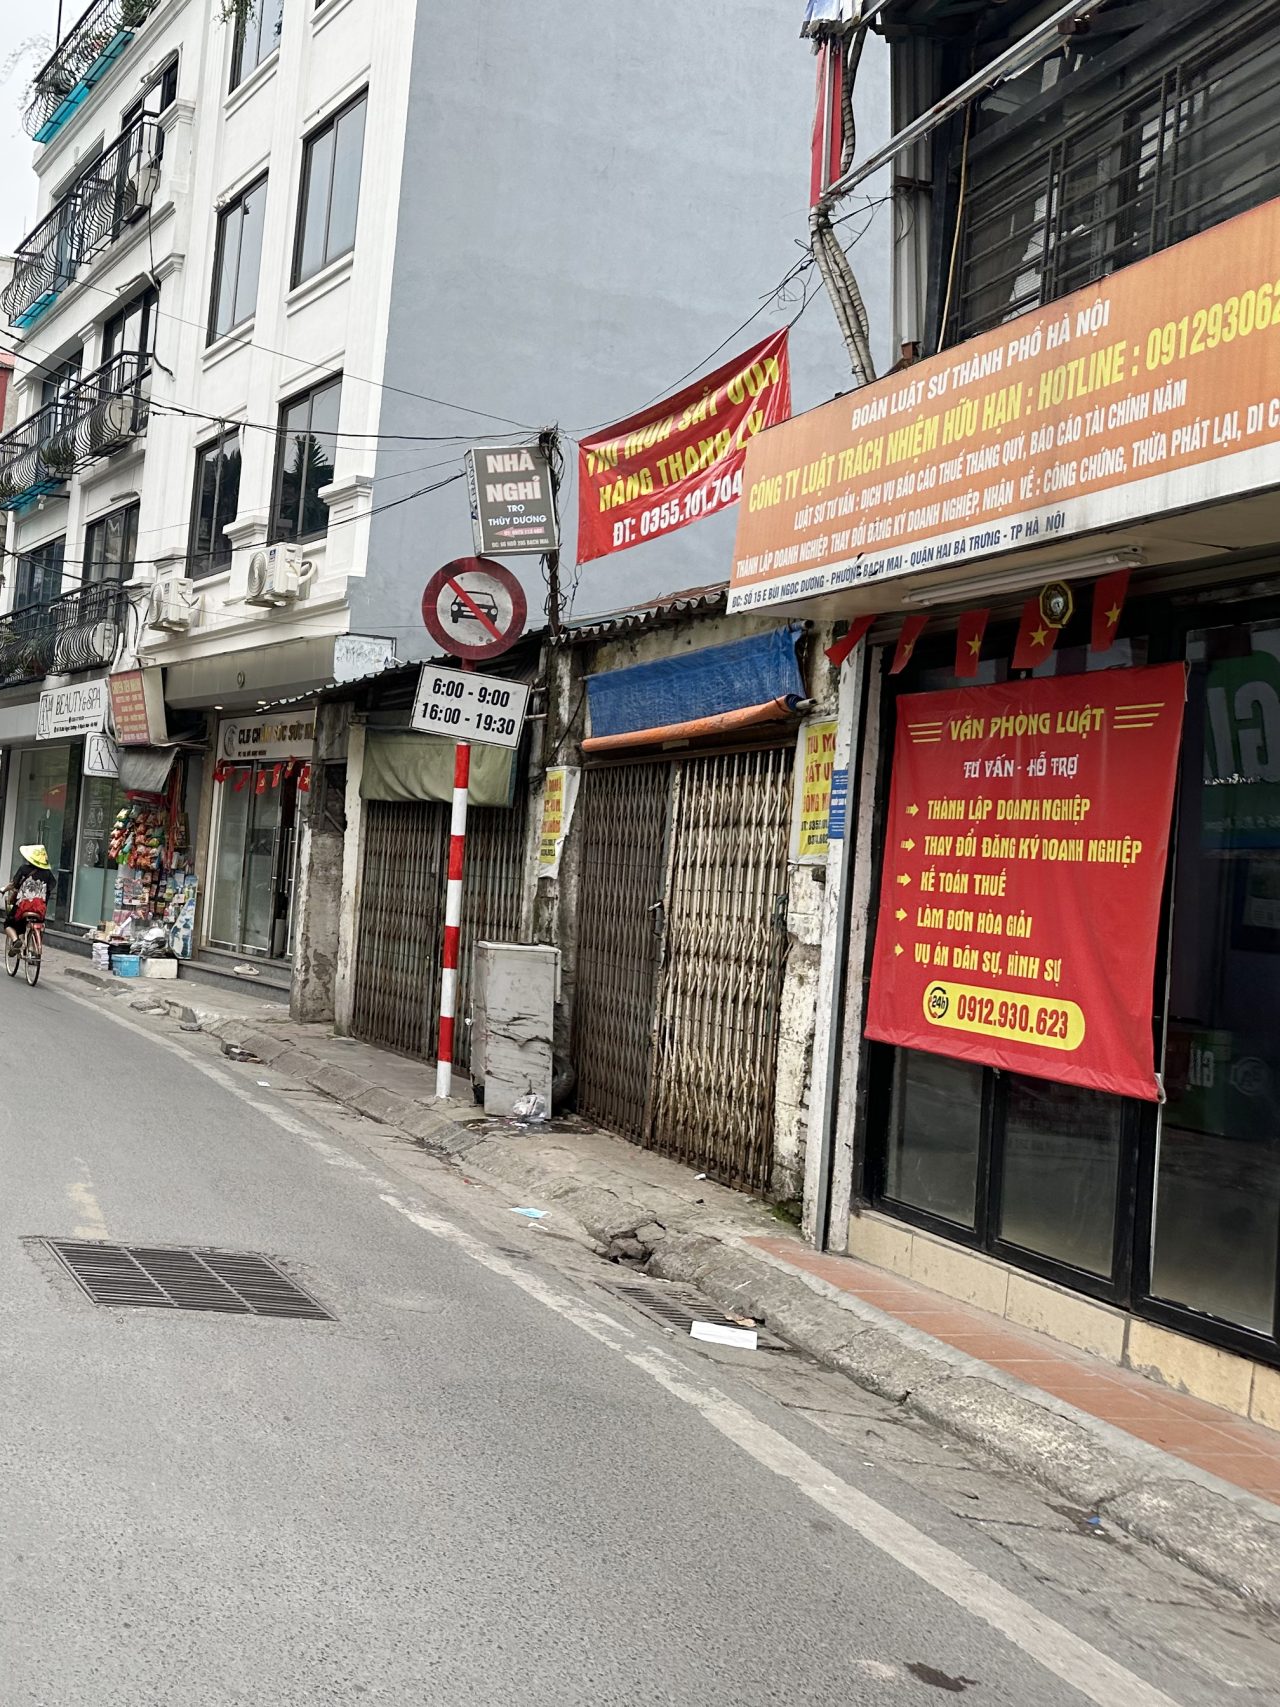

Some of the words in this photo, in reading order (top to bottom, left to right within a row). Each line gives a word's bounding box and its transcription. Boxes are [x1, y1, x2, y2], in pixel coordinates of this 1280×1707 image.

[851, 397, 888, 431] ĐOÀN
[890, 381, 925, 416] LUẬT
[927, 368, 950, 400] SƯ
[952, 353, 1003, 390] THÀNH
[1006, 320, 1045, 368] PHỐ
[1046, 313, 1071, 351] HÀ
[1075, 298, 1111, 337] NỘI
[623, 414, 675, 459] MUA
[749, 470, 783, 513] CÔNG
[784, 467, 801, 501] TY
[801, 452, 836, 497] LUẬT
[837, 437, 884, 482] TRÁCH
[885, 414, 940, 465] NHIỆM
[941, 396, 980, 446] HỮU
[981, 383, 1023, 434] HẠN
[1037, 341, 1128, 411] HOTLINE
[485, 449, 535, 473] NHÀ
[656, 428, 731, 487] THANH
[485, 475, 542, 503] NGHỈ
[506, 504, 525, 514] TRỌ
[512, 514, 547, 525] DƯƠNG
[613, 514, 635, 547] ĐT:
[639, 469, 743, 537] 0355.101.704
[731, 595, 743, 608] ĐC:
[754, 589, 762, 604] 15
[800, 574, 825, 593] DƯƠNG
[886, 555, 903, 572] MAI
[910, 545, 934, 567] QUẬN
[936, 542, 951, 560] HAI
[953, 535, 966, 554] BÀ
[1010, 523, 1023, 541] TP
[1025, 516, 1040, 537] HÀ
[1045, 510, 1066, 533] NỘI
[432, 678, 465, 699] 6:00
[477, 686, 510, 708] 9:00
[422, 702, 462, 725] 16:00
[475, 712, 516, 736] 19:30
[950, 715, 985, 742] VĂN
[989, 710, 1052, 740] PHÒNG
[1056, 704, 1105, 739] LUẬT
[964, 758, 983, 779] TƯ
[984, 754, 1014, 777] VẤN
[1027, 751, 1047, 777] HỖ
[1051, 754, 1079, 780] TRỢ
[927, 796, 965, 820] THÀNH
[968, 795, 993, 825] LẬP
[996, 798, 1040, 821] DOANH
[1042, 794, 1091, 826] NGHIỆP
[924, 835, 953, 856] THAY
[955, 828, 977, 857] ĐỔI
[981, 834, 1016, 858] ĐĂNG
[1018, 834, 1040, 860] KÝ
[1041, 838, 1083, 862] DOANH
[1087, 835, 1143, 868] NGHIỆP
[920, 864, 936, 892] KẾ
[938, 868, 969, 894] TOÁN
[973, 868, 1008, 897] THUẾ
[916, 904, 944, 929] LÀM
[946, 909, 974, 932] ĐƠN
[976, 909, 1003, 936] HÒA
[1006, 909, 1033, 938] GIẢI
[914, 943, 931, 969] VỤ
[933, 941, 949, 966] ÁN
[952, 944, 979, 971] DÂN
[982, 950, 1003, 978] SỰ,
[1007, 951, 1040, 979] HÌNH
[1043, 958, 1062, 987] SỰ
[931, 994, 947, 1010] 24h
[956, 994, 1069, 1040] 0912.930.623
